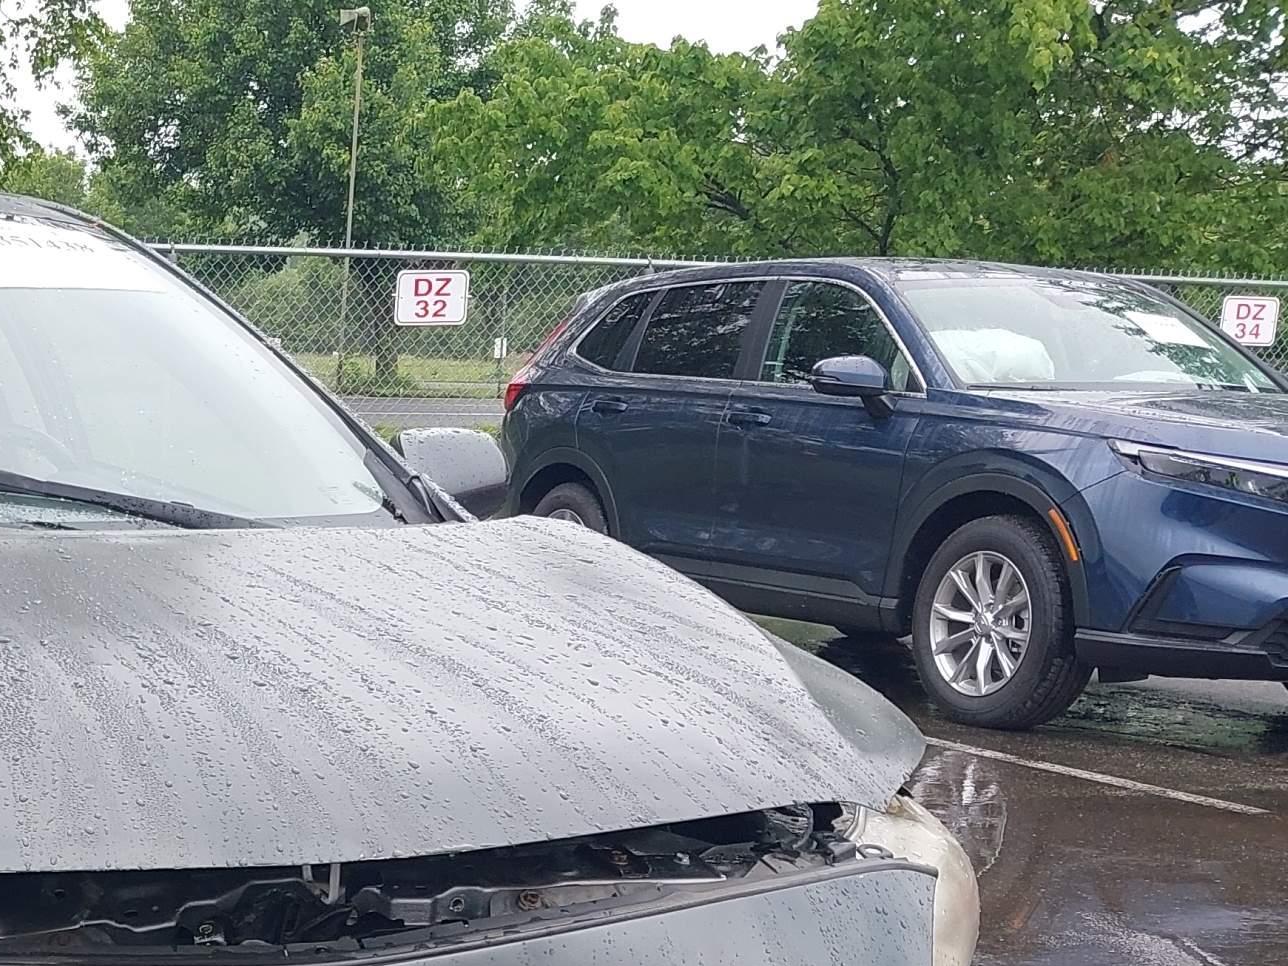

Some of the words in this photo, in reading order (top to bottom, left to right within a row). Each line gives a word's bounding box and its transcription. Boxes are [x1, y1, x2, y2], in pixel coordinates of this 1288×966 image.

[414, 278, 452, 296] DZ
[414, 300, 447, 318] 32
[1236, 304, 1266, 320] DZ
[1234, 323, 1261, 339] 34
